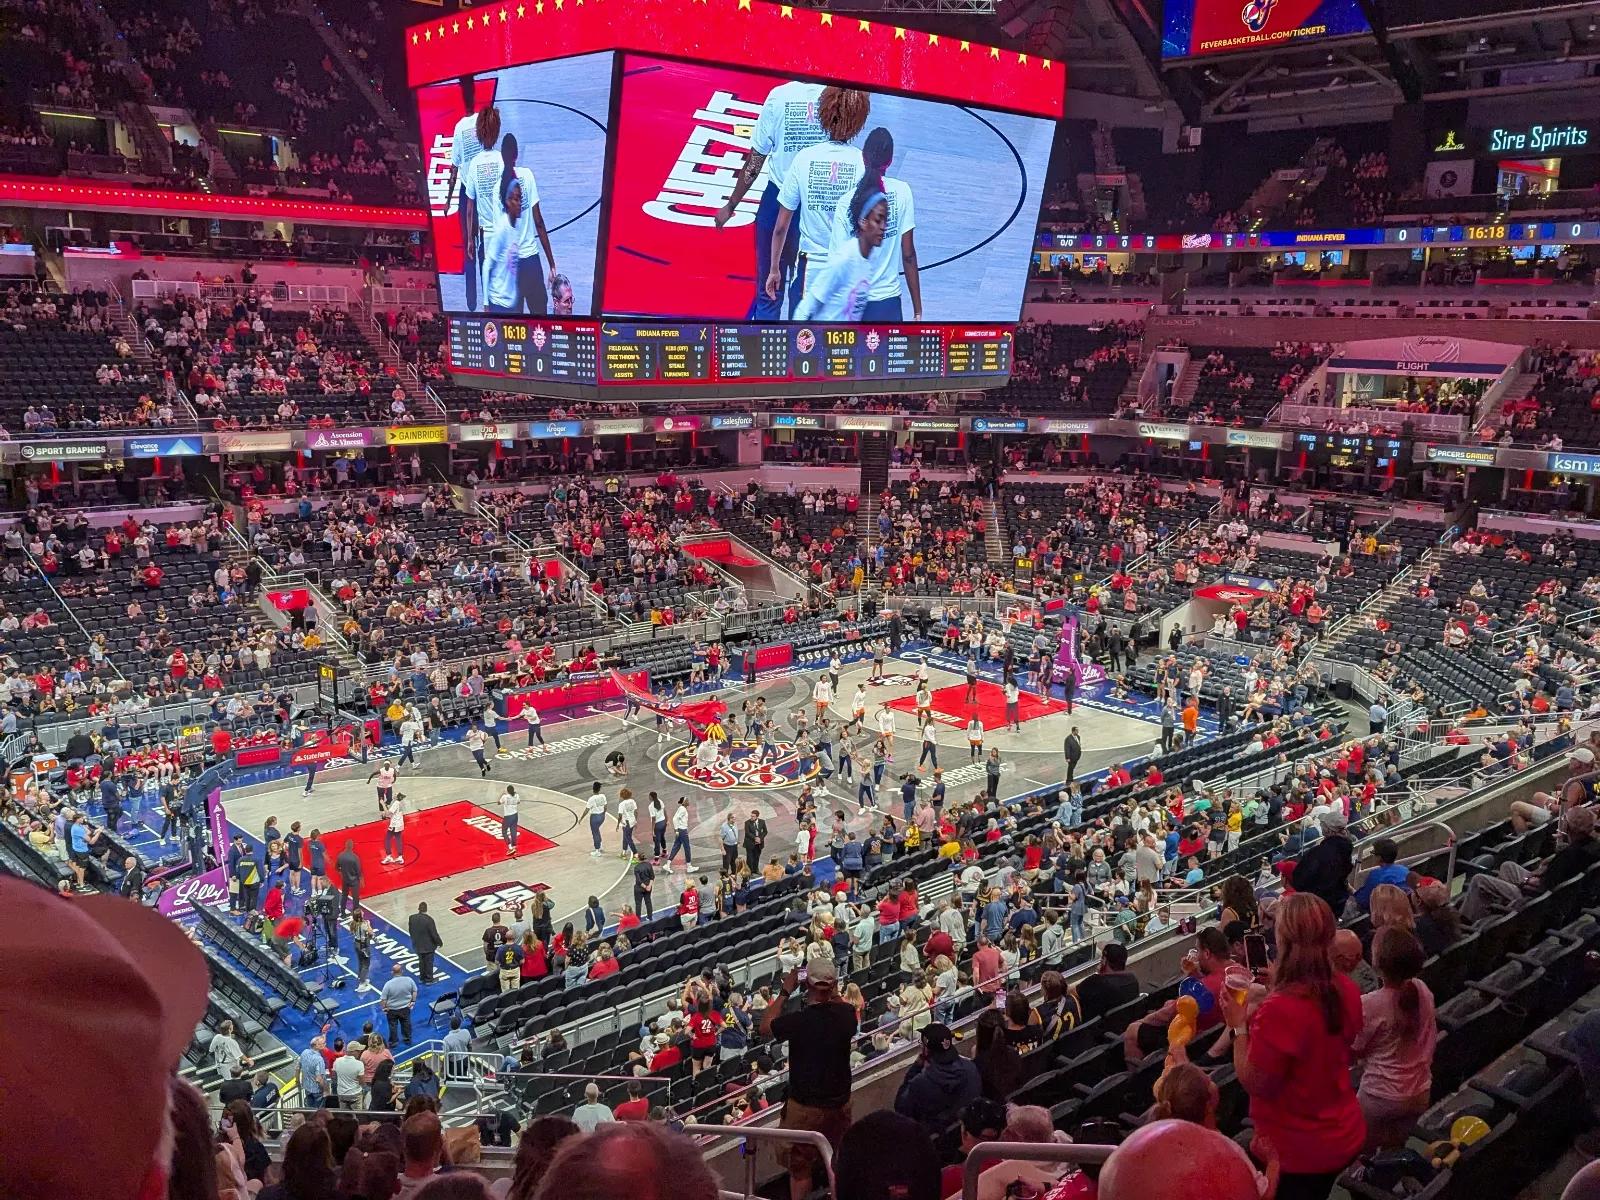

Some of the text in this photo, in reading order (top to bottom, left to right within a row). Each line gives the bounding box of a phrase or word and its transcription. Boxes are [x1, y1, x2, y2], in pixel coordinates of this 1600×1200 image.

[1201, 25, 1326, 49] FEVERBASKETBALL.COM/TICKETS
[1491, 126, 1587, 151] Sire Spirits
[1399, 230, 1407, 240] 0
[1469, 227, 1505, 239] 16:18
[1572, 224, 1581, 236] 0
[1122, 239, 1127, 247] 0
[503, 326, 526, 339] 16:18
[827, 332, 854, 344] 16:18
[489, 355, 494, 367] 0
[537, 359, 543, 372] 0
[869, 360, 875, 372] 0
[1397, 362, 1429, 370] FLIGHT
[802, 361, 809, 373] 0
[723, 416, 752, 426] salesforce
[547, 423, 566, 436] Kroger
[399, 430, 444, 440] GAINBRIDGE
[1249, 435, 1280, 444] Kinetico
[1299, 434, 1317, 442] FEVER
[339, 438, 364, 446] Vincent
[36, 447, 63, 455] SPORT
[66, 446, 106, 454] GRAPHICS
[1392, 449, 1398, 457] 0
[1437, 450, 1465, 458] PACERS
[1466, 451, 1495, 461] GAMING
[1554, 455, 1588, 471] ksm
[174, 880, 224, 906] Lilly
[495, 932, 501, 941] 0
[505, 951, 514, 960] 22
[701, 1019, 712, 1029] 22
[726, 1014, 735, 1024] 22
